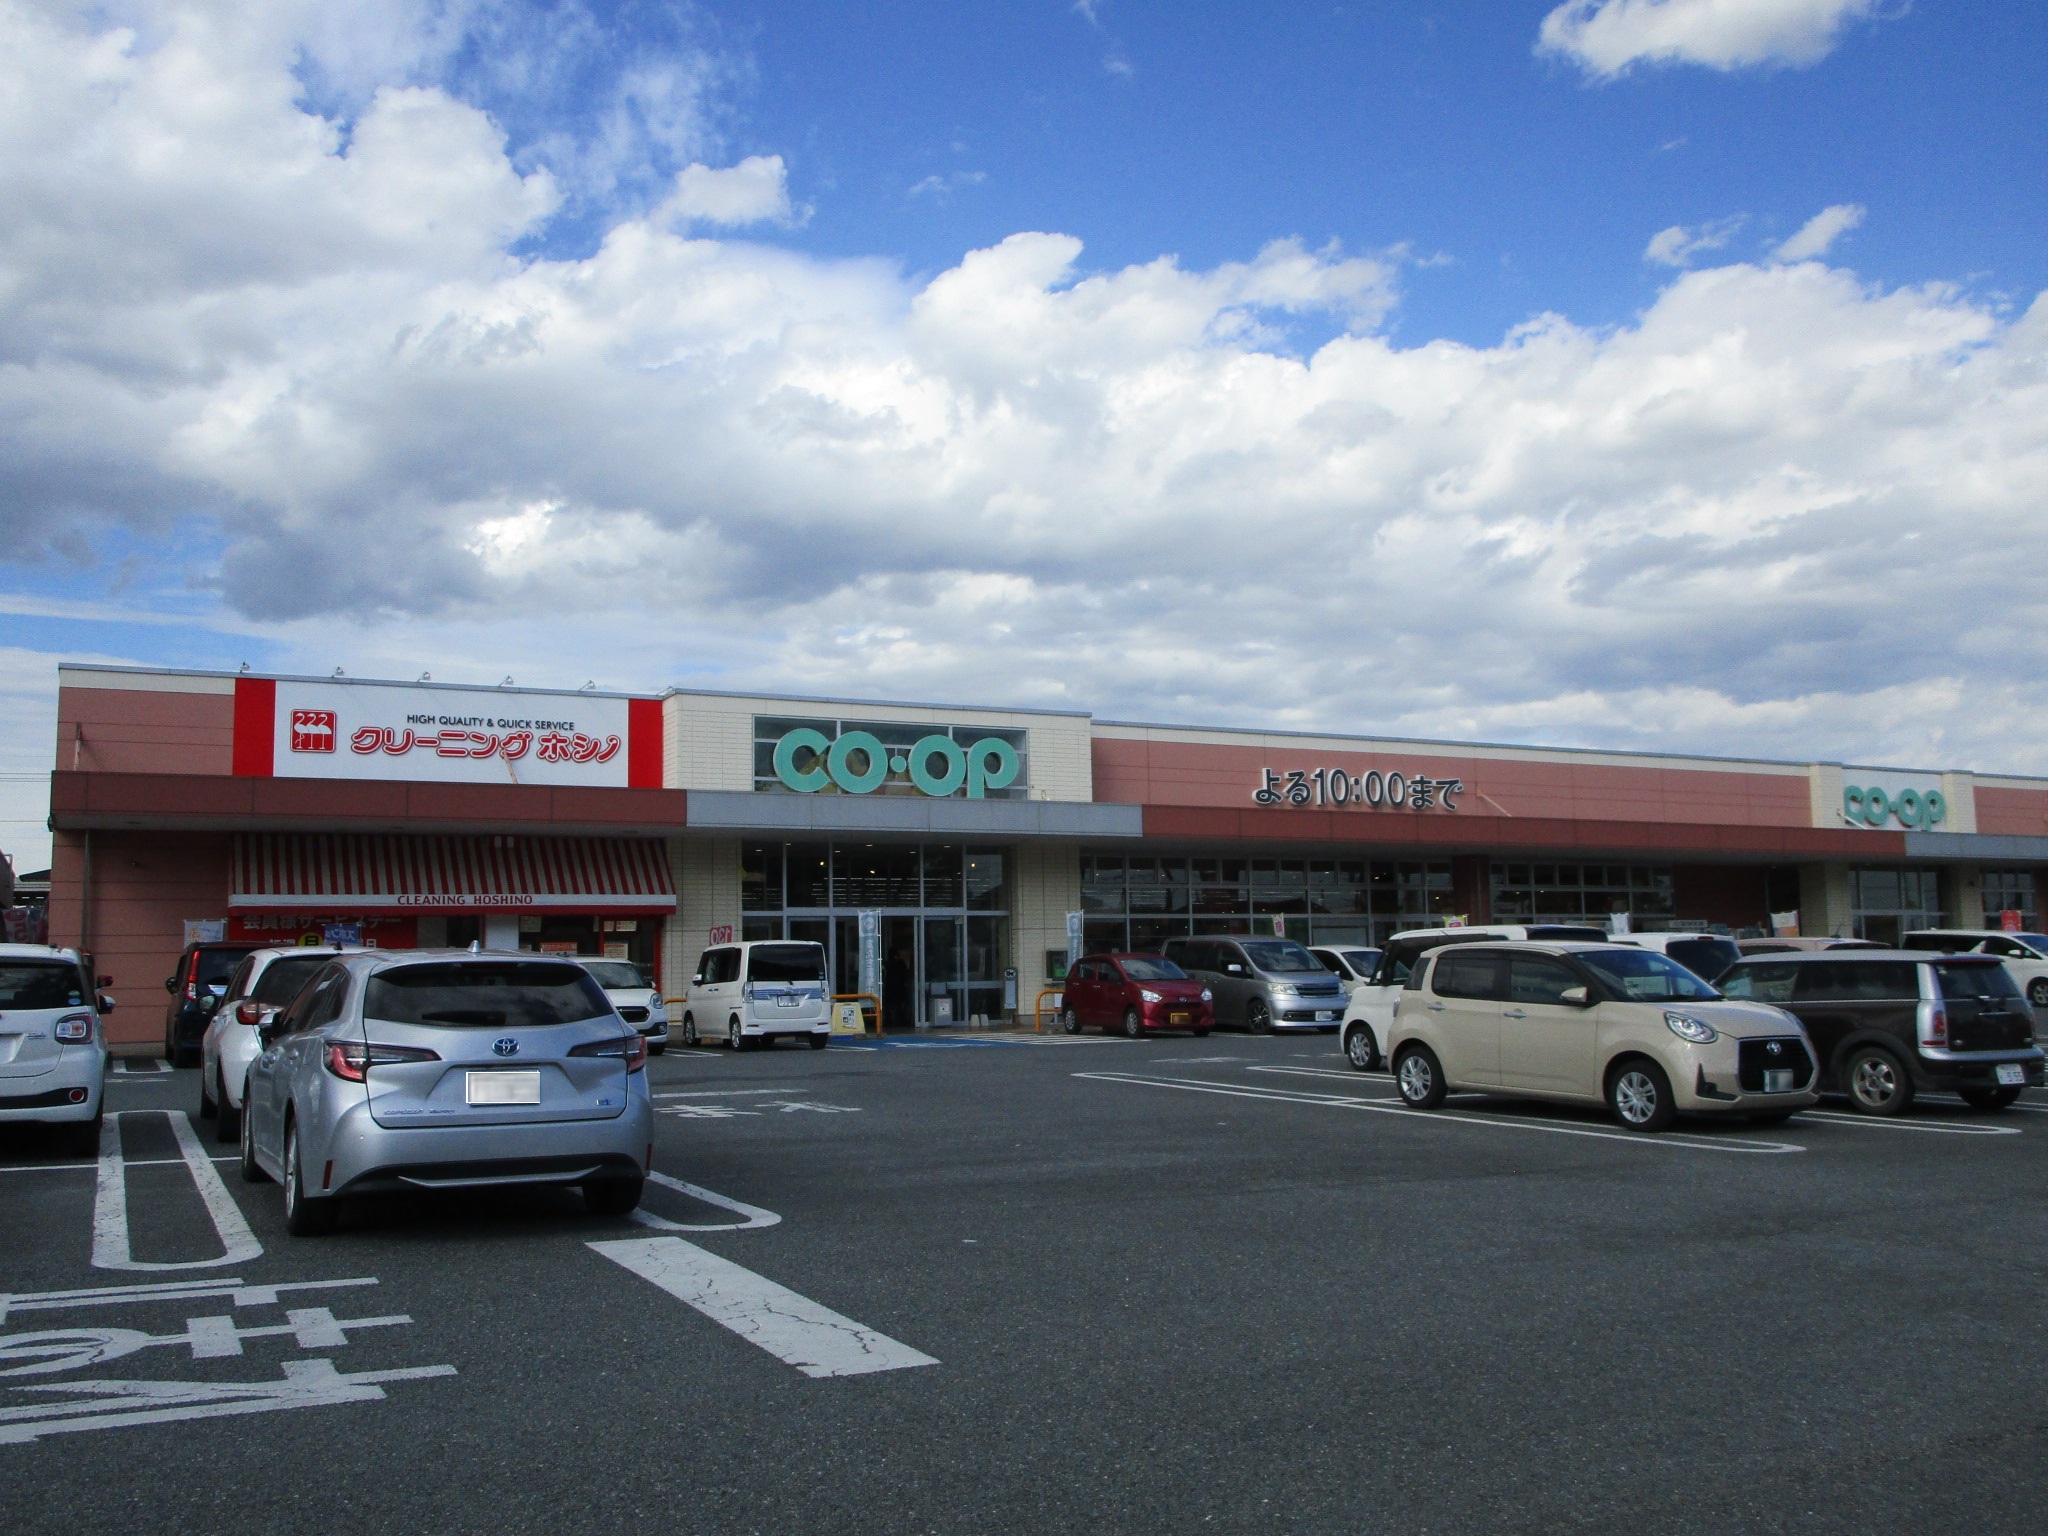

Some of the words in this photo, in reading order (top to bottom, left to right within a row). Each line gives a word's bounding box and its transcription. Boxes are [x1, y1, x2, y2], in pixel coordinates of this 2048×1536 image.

[406, 713, 435, 725] HIGH
[439, 715, 485, 727] QUALITY
[486, 717, 495, 728] &
[497, 718, 533, 730] QUICK
[535, 719, 575, 731] SERVICE
[351, 726, 534, 760] クリーニング
[537, 730, 622, 763] ホシノ
[1251, 766, 1465, 811] よる10:00まで
[397, 894, 466, 906] CLEANING
[473, 894, 533, 905] HOSHINO
